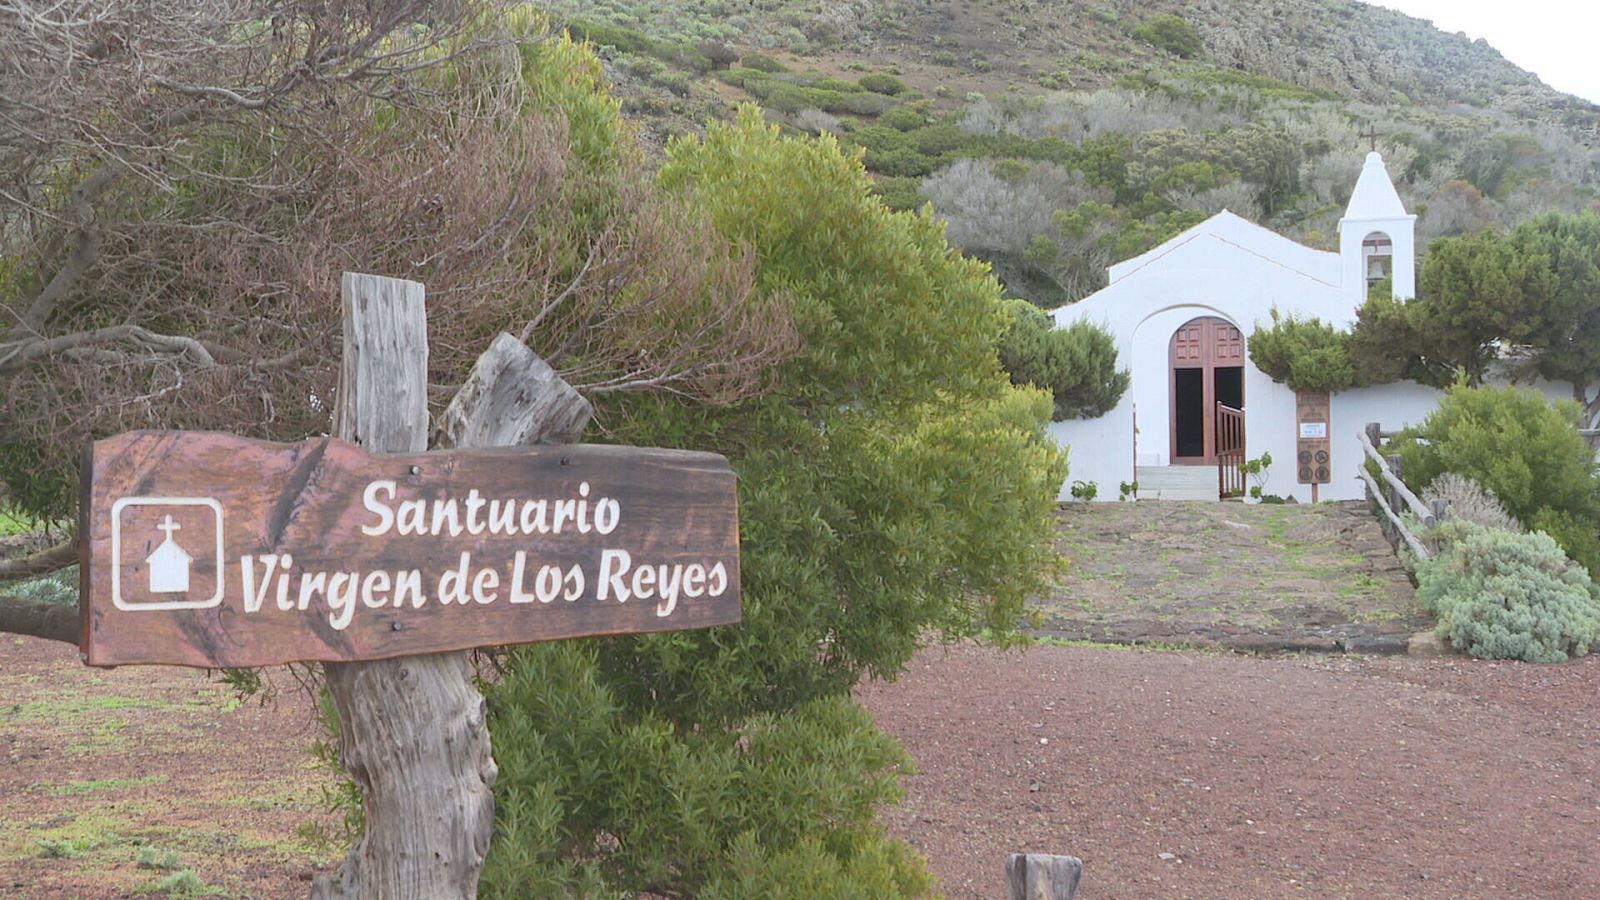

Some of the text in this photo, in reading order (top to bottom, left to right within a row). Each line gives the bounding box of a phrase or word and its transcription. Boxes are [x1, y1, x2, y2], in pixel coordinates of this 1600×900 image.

[362, 481, 621, 536] Santuario
[240, 548, 728, 630] Virgen de Los Reyes
